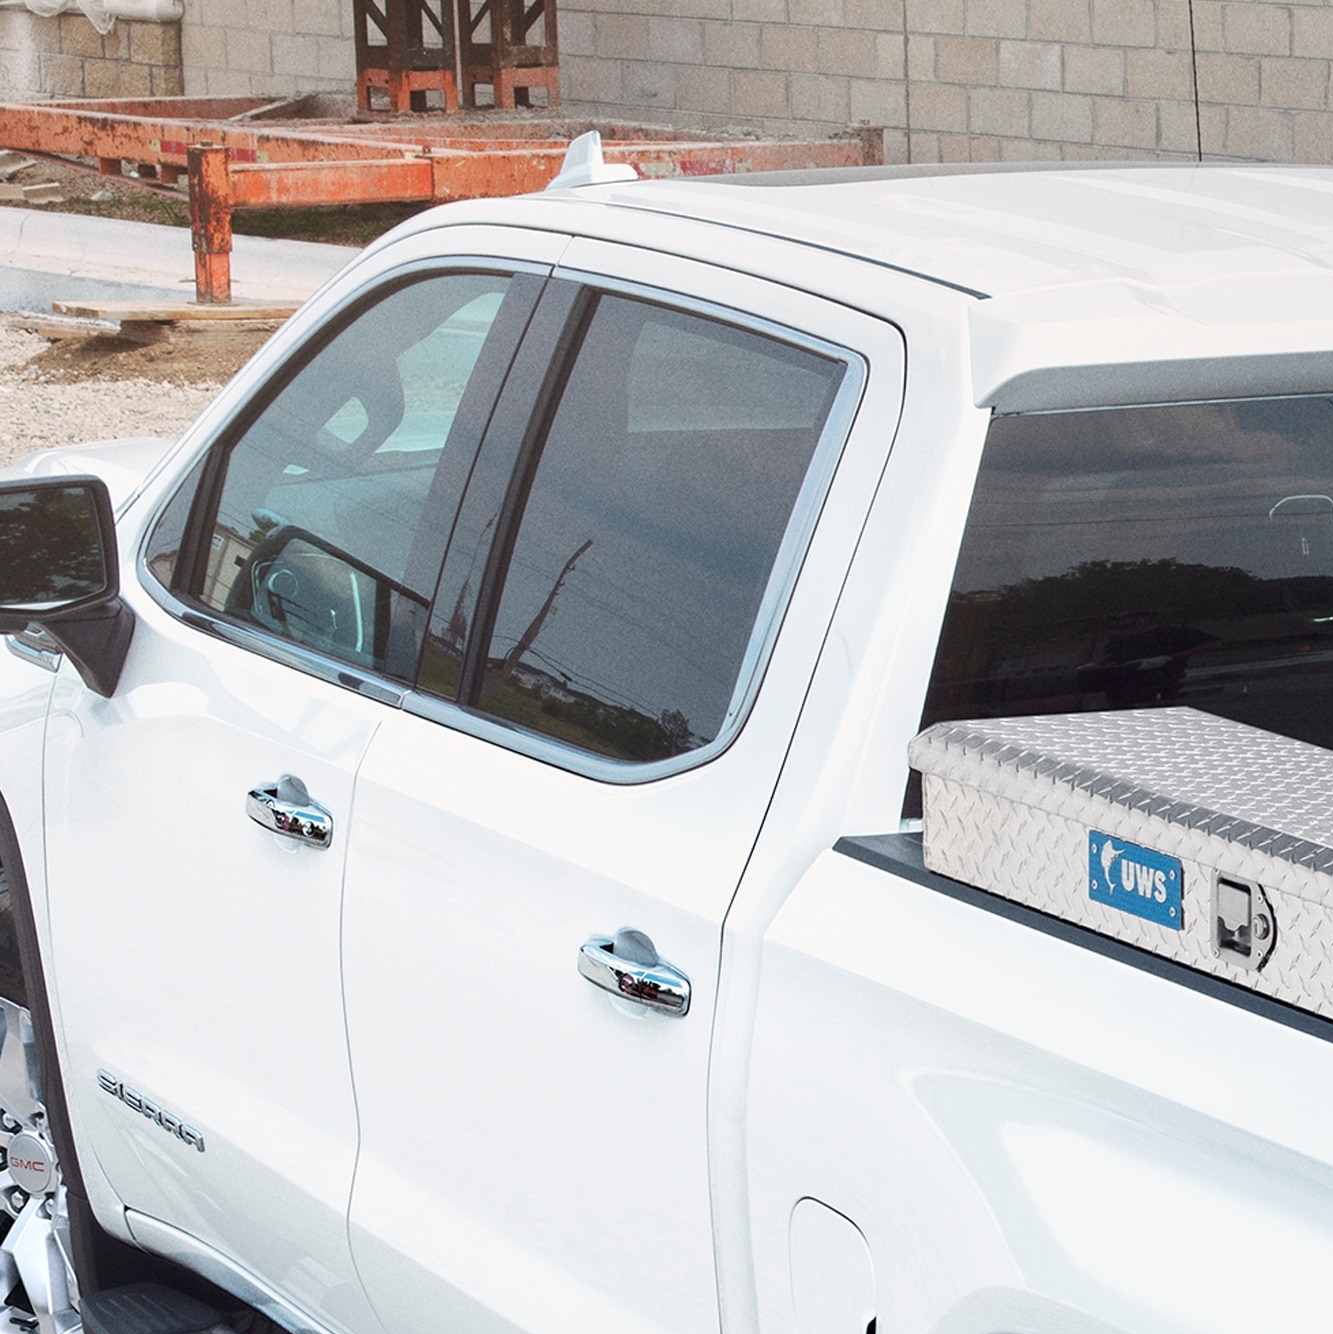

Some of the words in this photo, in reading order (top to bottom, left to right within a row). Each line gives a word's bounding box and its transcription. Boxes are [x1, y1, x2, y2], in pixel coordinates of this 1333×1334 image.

[1120, 858, 1168, 904] UWS
[97, 1068, 206, 1153] SIERRA
[10, 1156, 45, 1173] GMC
